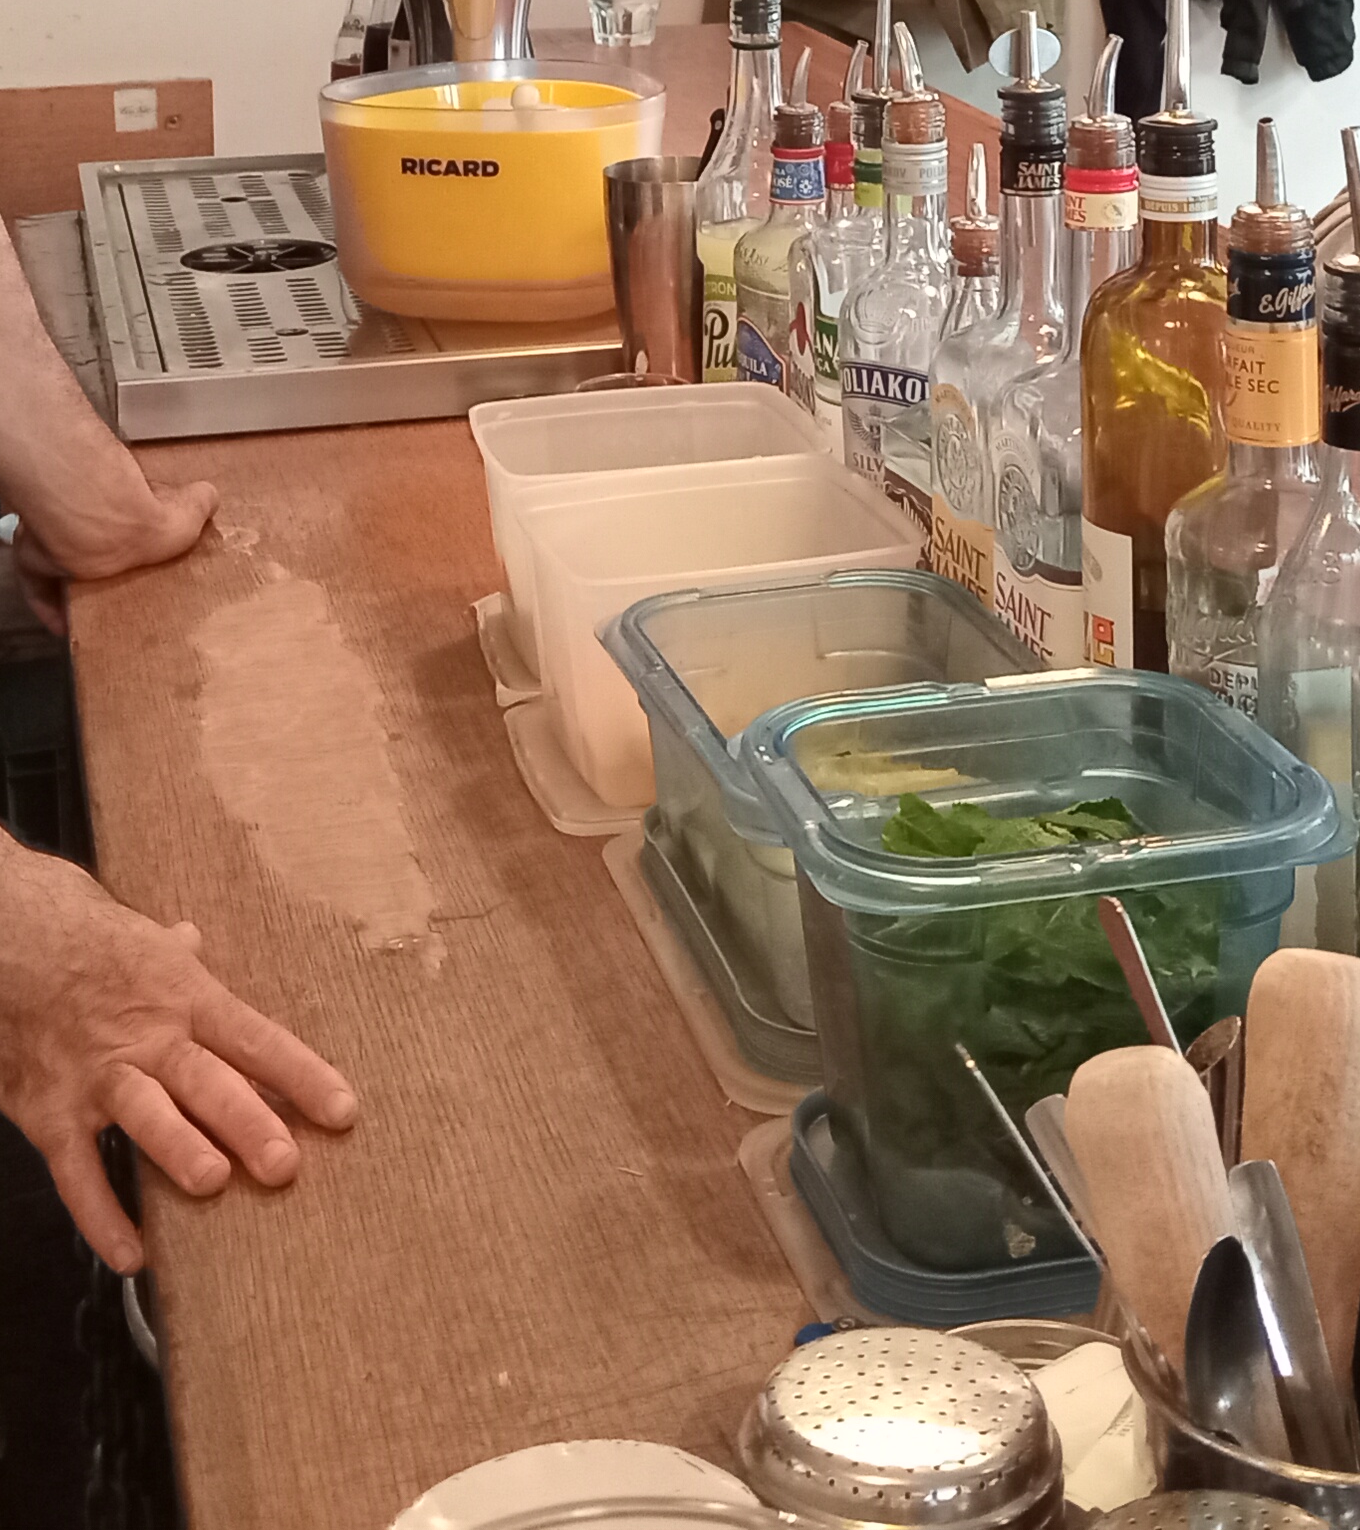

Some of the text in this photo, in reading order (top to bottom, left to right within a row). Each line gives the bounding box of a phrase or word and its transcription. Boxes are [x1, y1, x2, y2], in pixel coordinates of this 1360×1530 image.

[400, 157, 500, 178] RICARD
[1018, 161, 1061, 176] SAINT
[1013, 174, 1062, 189] JAMES
[842, 366, 930, 404] OLIAKO
[1247, 378, 1280, 394] SEC
[852, 451, 885, 473] SILV
[934, 516, 986, 582] SAINT
[995, 571, 1052, 643] SAINT
